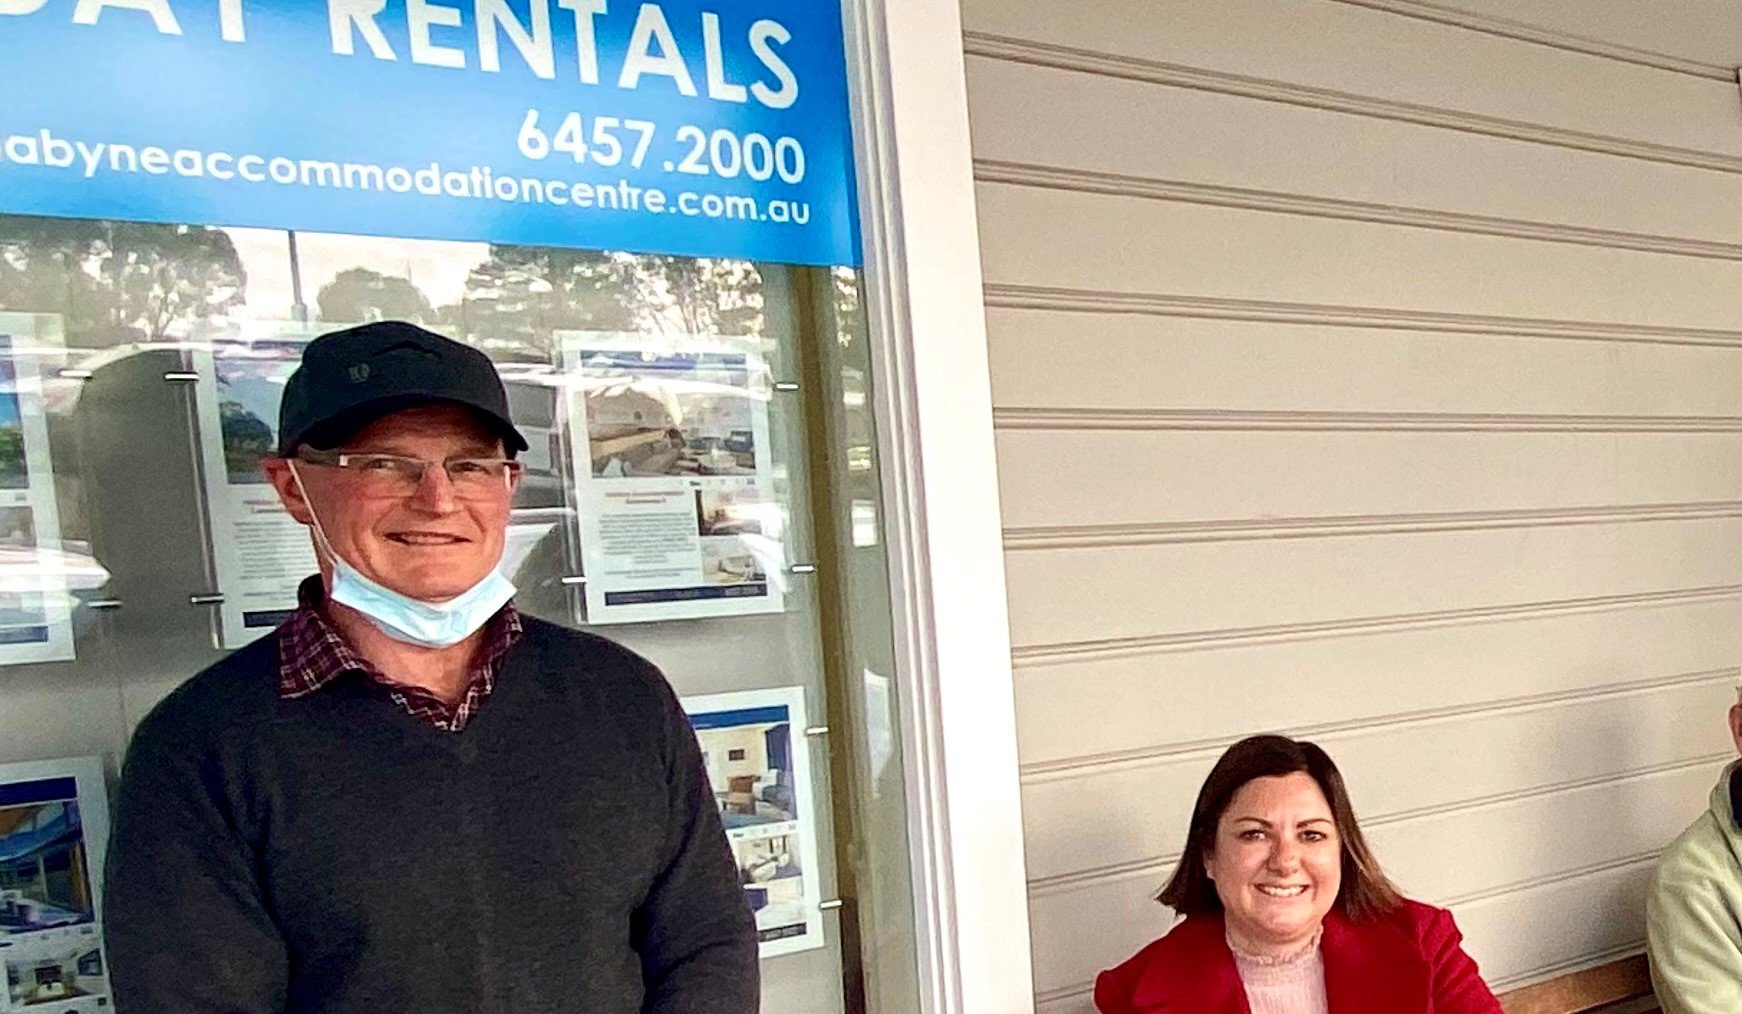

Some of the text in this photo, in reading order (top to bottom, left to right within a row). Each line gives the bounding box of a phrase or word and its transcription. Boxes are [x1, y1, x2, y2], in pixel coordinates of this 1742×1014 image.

[327, 0, 799, 109] RENTALS
[0, 128, 810, 225] abyneaccommodationcentre.com.au
[517, 108, 806, 184] 6457.2000
